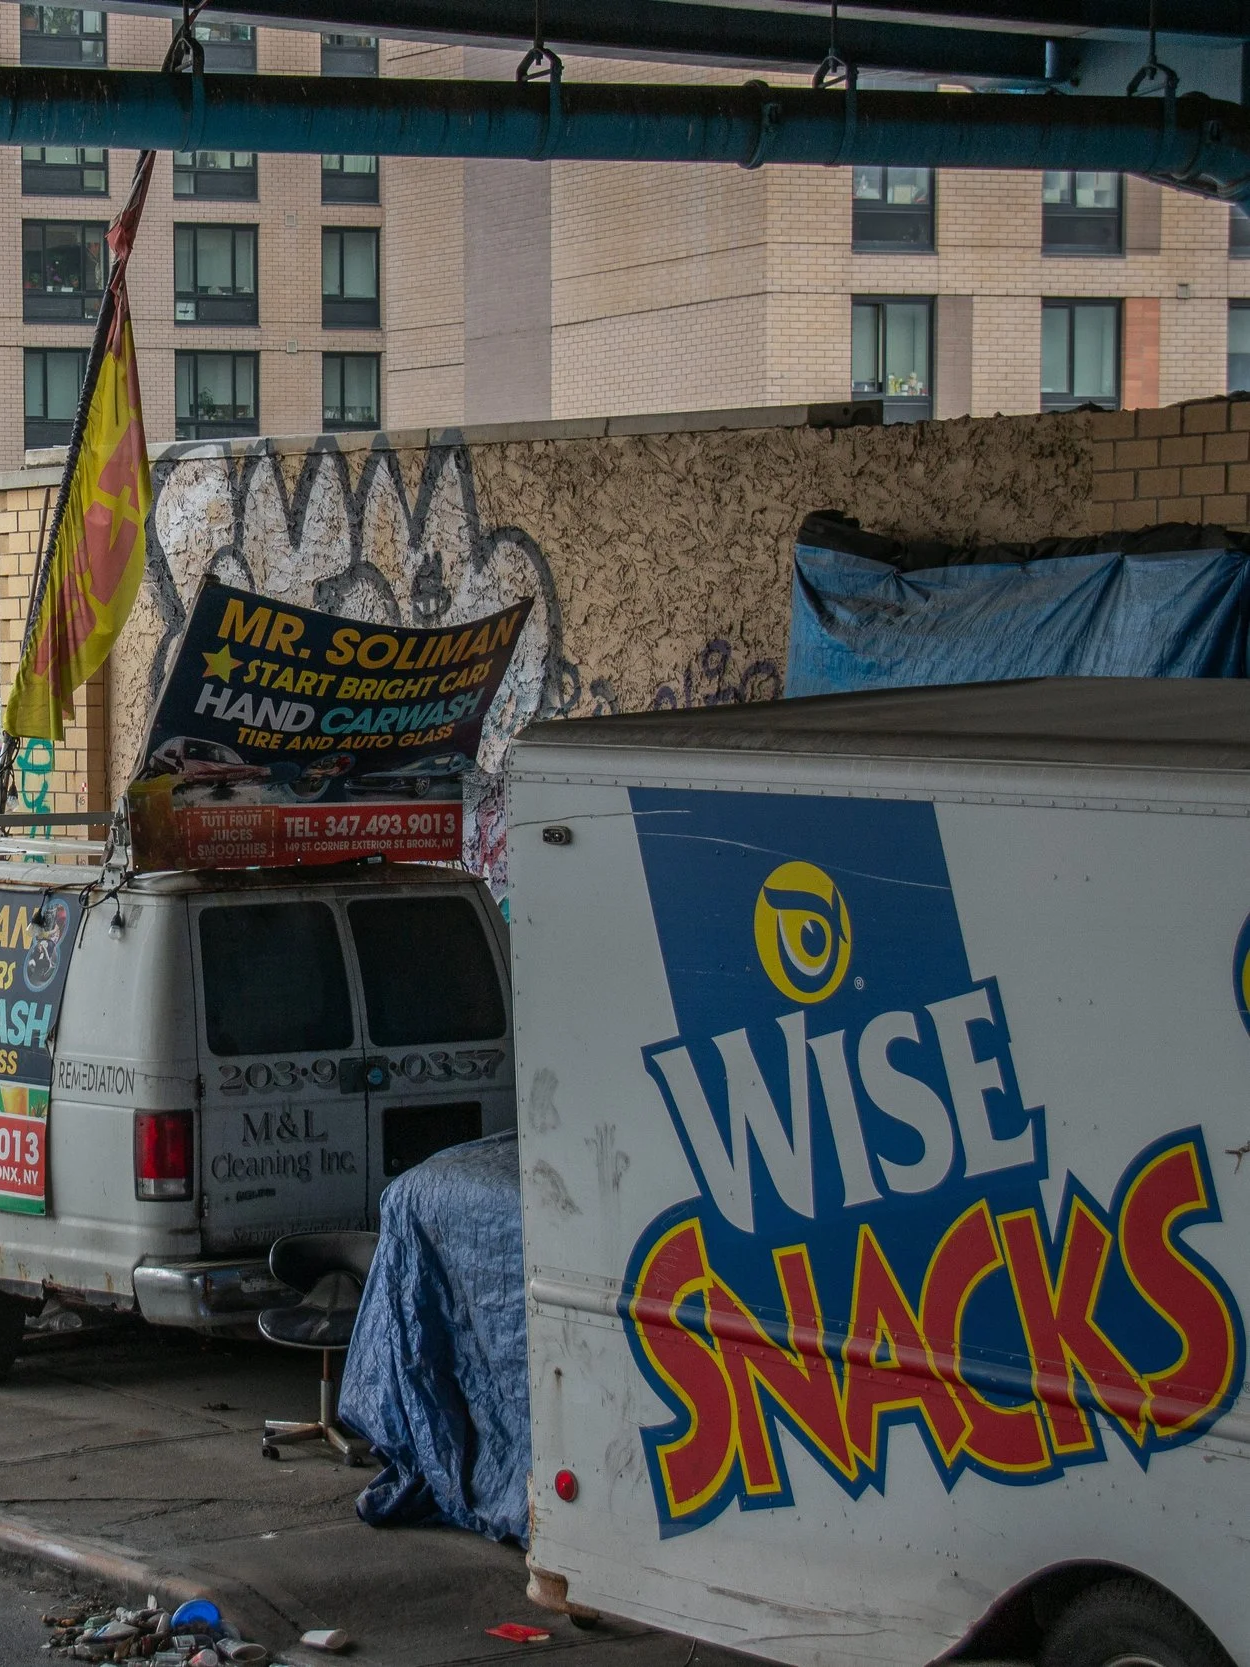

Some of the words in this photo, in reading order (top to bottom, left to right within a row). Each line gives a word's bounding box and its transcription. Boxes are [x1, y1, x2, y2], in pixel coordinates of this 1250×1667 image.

[217, 598, 311, 659] MR.
[325, 611, 521, 671] SOLIMAN
[242, 659, 337, 696] START
[336, 675, 438, 702] BRIGHT
[438, 659, 493, 695] CARS
[194, 683, 315, 732] HAND
[319, 688, 486, 735] CARWASH
[237, 727, 283, 750] TIRE
[285, 733, 334, 751] AND
[338, 733, 395, 751] AUTO
[398, 723, 455, 748] GLASS
[200, 814, 227, 827] TUTI
[229, 813, 261, 827] FRUTI
[210, 828, 253, 841] JUICES
[284, 817, 319, 838] TEL:
[325, 813, 455, 838] 347.493.9013
[197, 843, 268, 857] SMOOTHIES
[284, 842, 298, 851] 149
[300, 841, 311, 851] ST.
[313, 840, 350, 851] CORNER
[351, 840, 392, 850] EXTERIOR
[394, 839, 405, 849] ST.
[407, 838, 441, 850] BRONX,
[442, 838, 454, 848] NY
[58, 1061, 135, 1096] REMEDIATION
[649, 987, 1036, 1233] WISE
[242, 1109, 329, 1146] M&L
[23, 1167, 39, 1185] NY
[211, 1150, 313, 1182] Cleaning
[634, 1140, 1236, 1519] SNACKS
